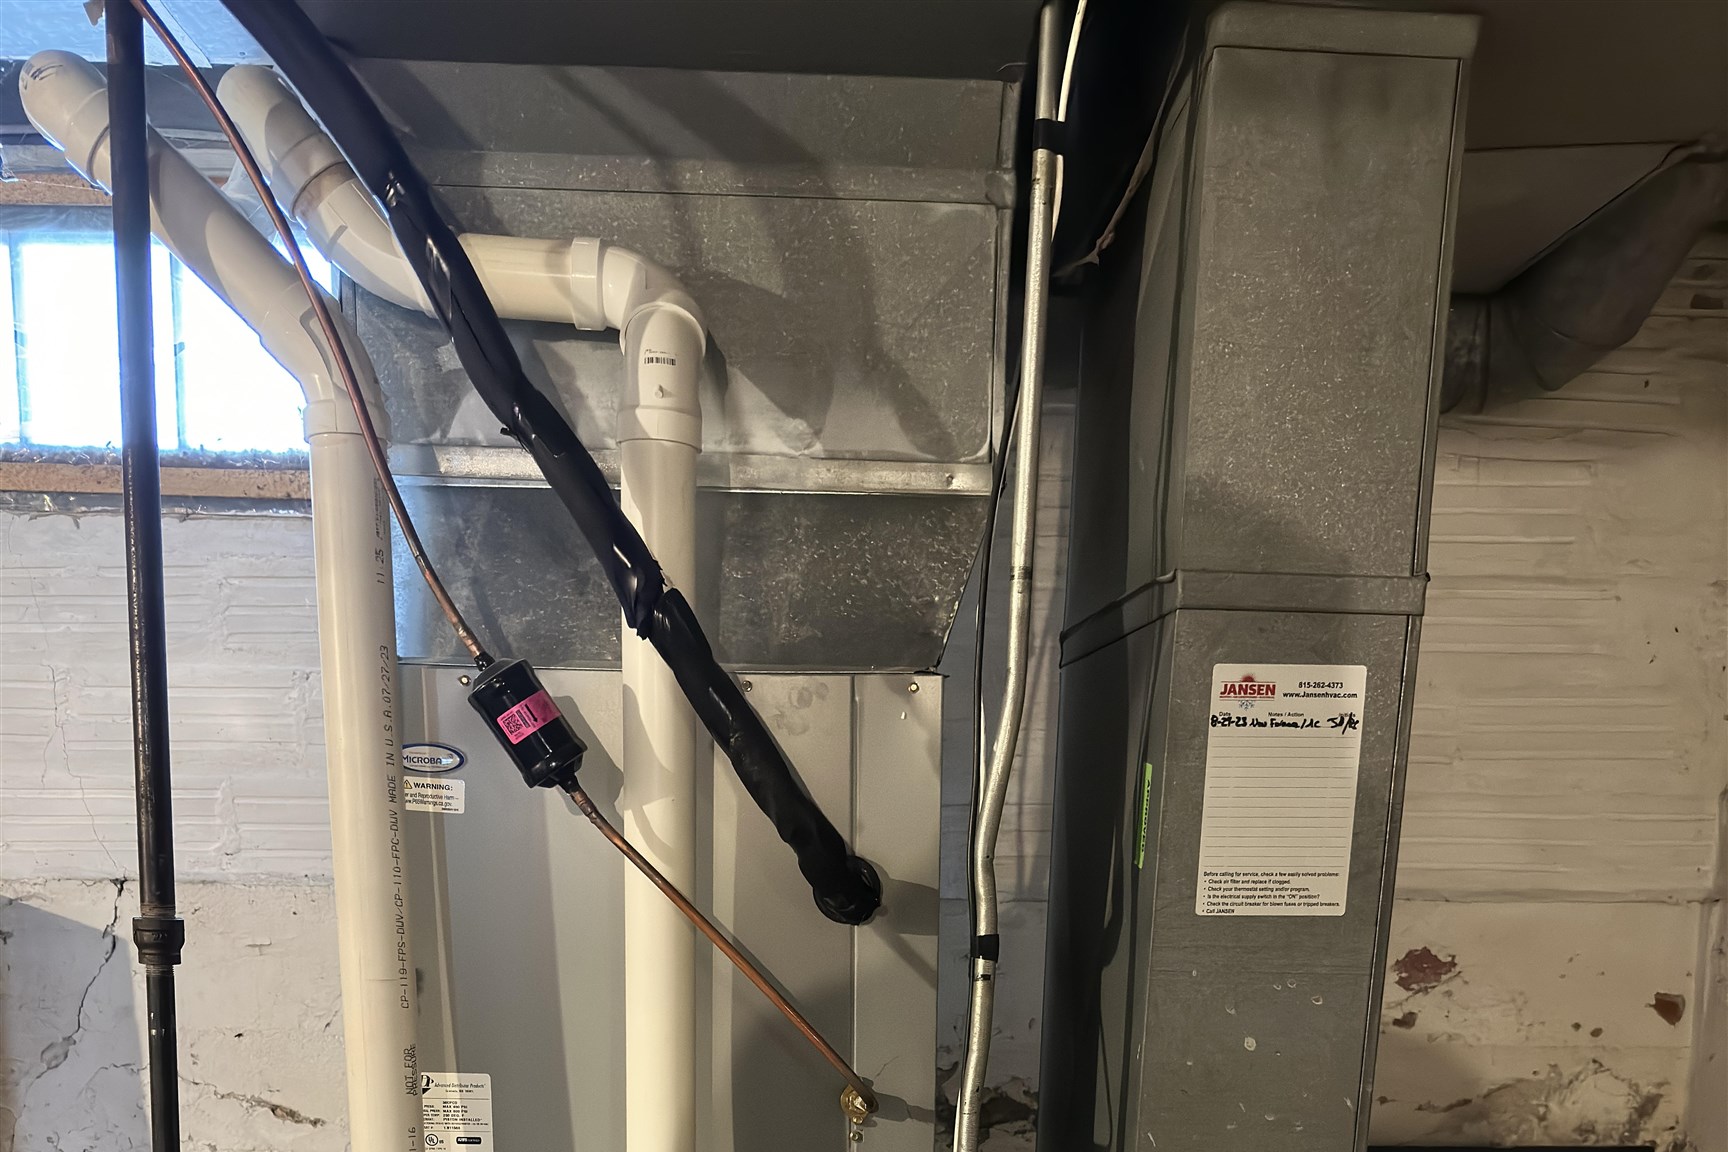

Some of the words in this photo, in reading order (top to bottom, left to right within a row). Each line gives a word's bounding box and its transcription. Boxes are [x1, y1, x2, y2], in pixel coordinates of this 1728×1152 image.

[1220, 684, 1276, 696] JANSEN
[385, 752, 395, 766] IN
[403, 755, 453, 765] MICROBA
[386, 774, 397, 804] MADE
[414, 783, 453, 791] WARNING:
[1141, 779, 1151, 852] APPROVED
[404, 1048, 412, 1068] FOR
[404, 1075, 414, 1095] NOT
